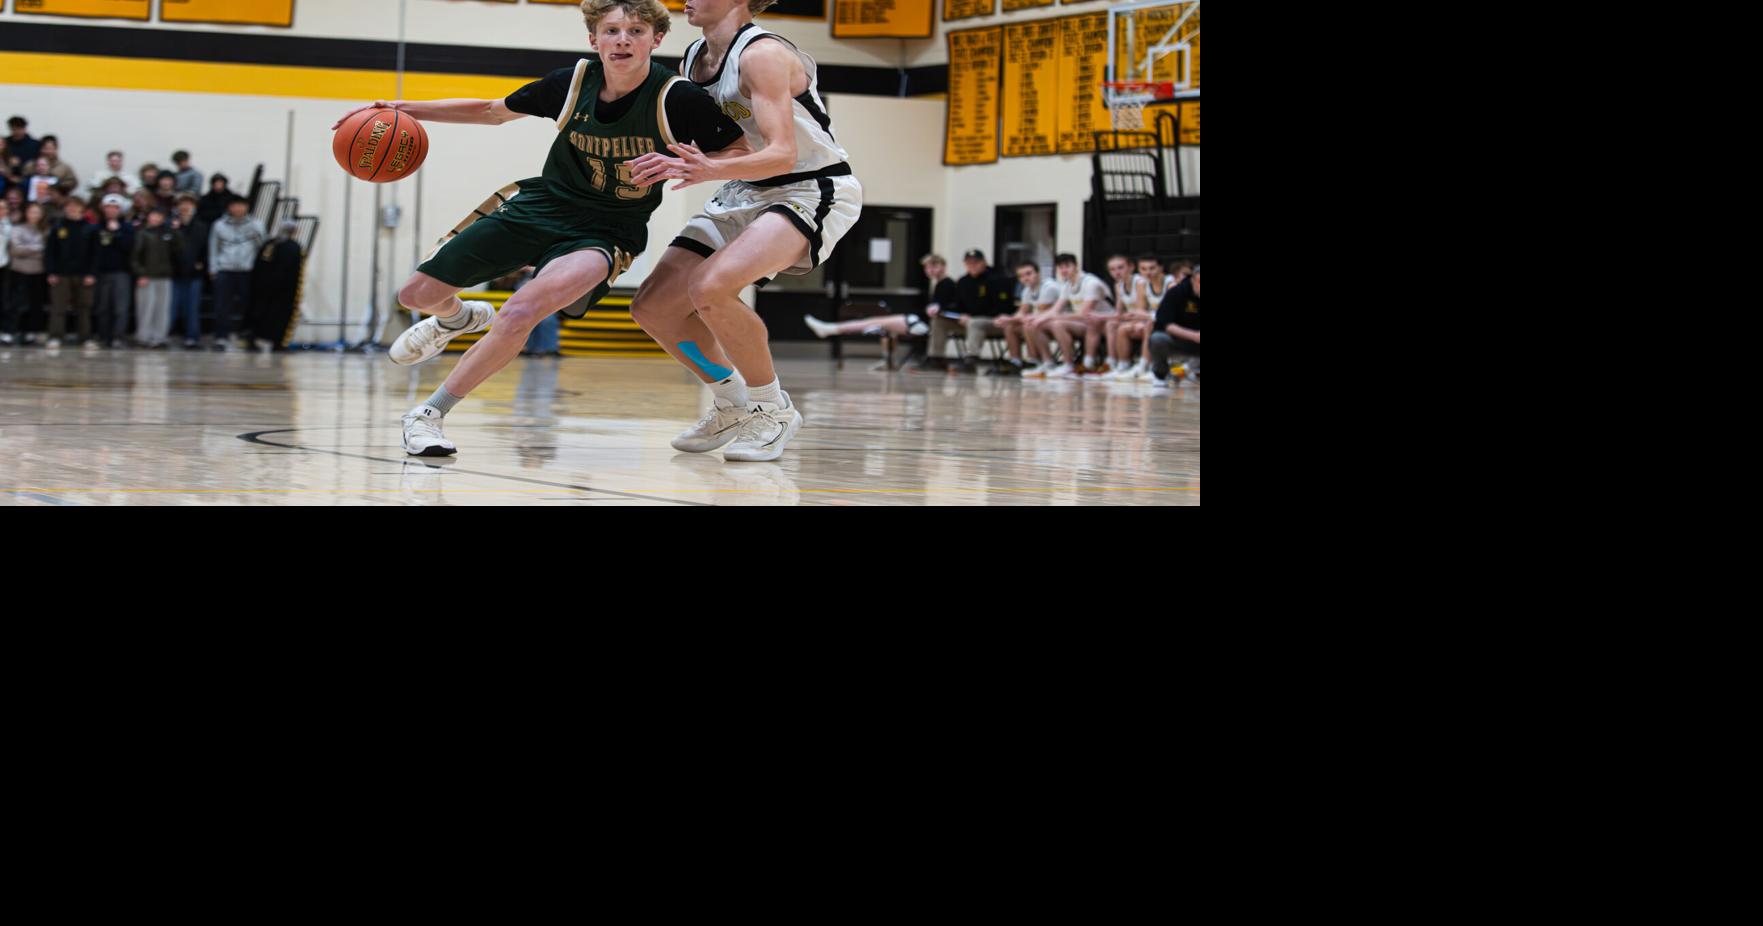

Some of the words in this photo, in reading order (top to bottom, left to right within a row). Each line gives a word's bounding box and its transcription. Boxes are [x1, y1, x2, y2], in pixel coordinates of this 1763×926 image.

[359, 120, 391, 172] SPALDING
[387, 130, 409, 174] LEGACY
[569, 130, 655, 157] MONTPELIER
[586, 156, 652, 200] 15
